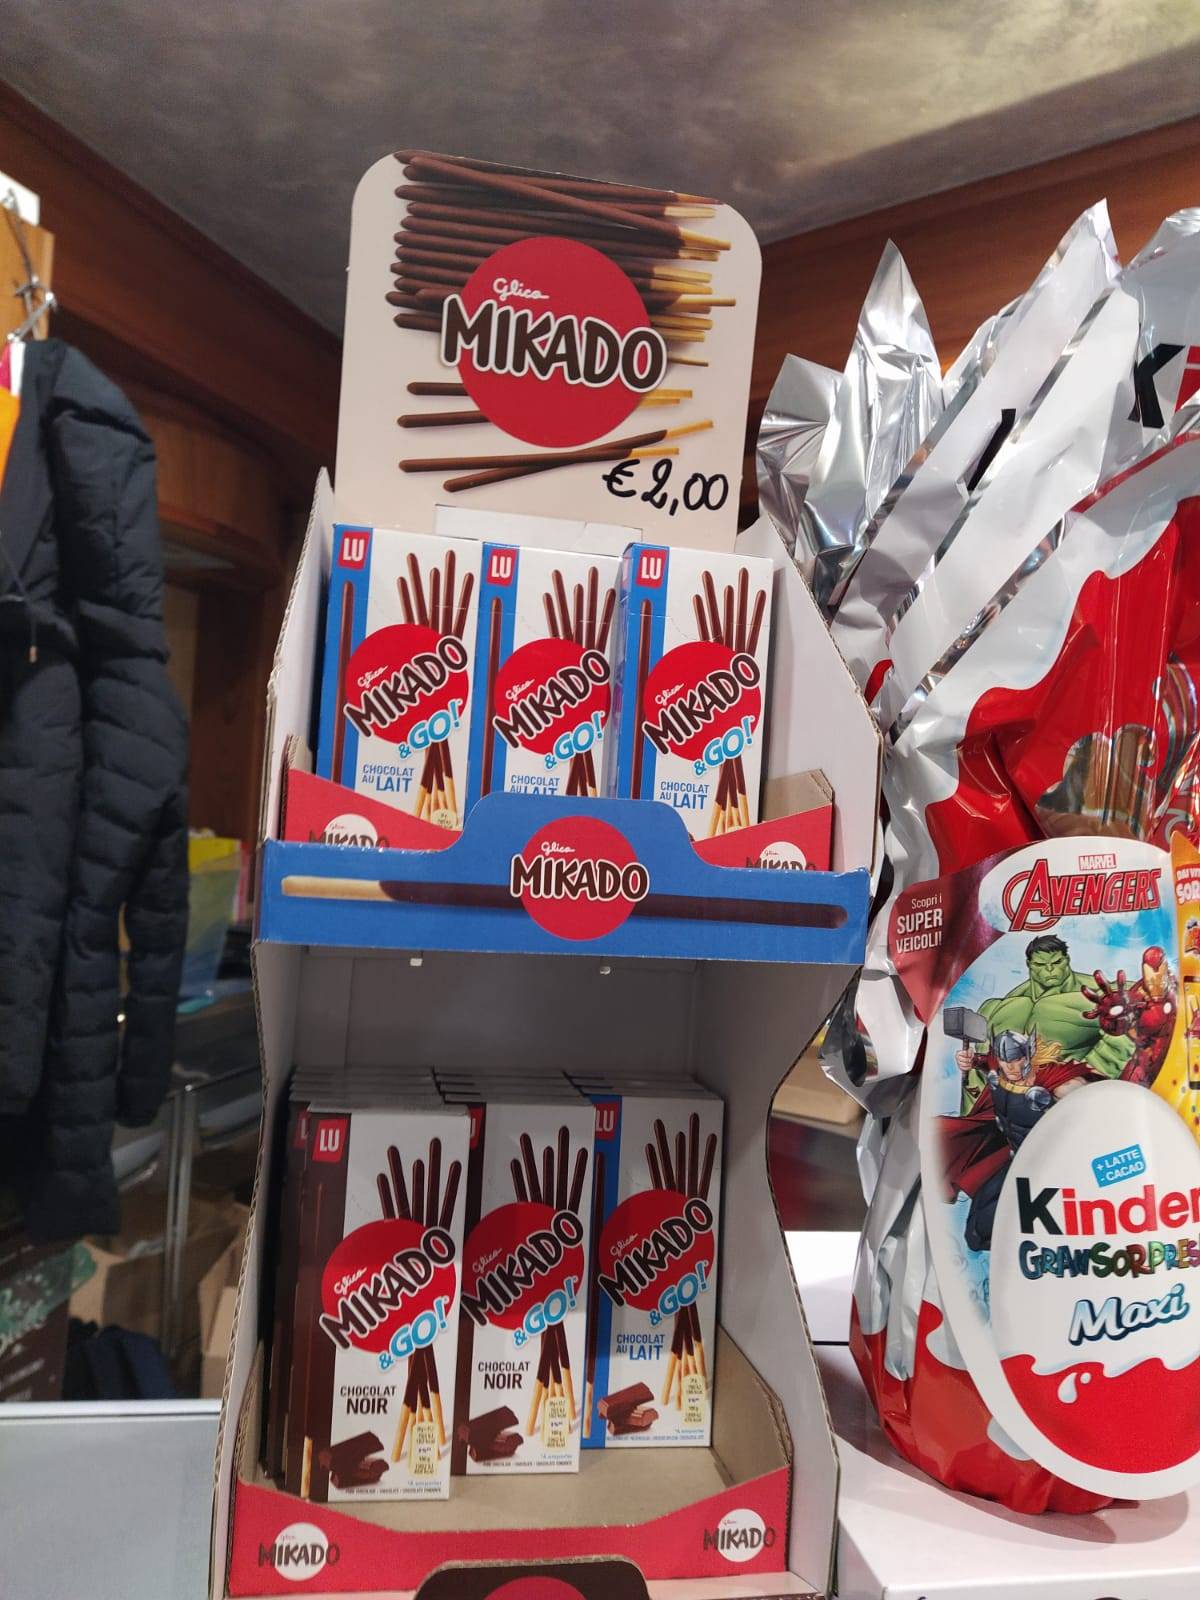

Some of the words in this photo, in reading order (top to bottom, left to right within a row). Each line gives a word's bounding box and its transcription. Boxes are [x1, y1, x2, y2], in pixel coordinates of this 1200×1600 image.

[441, 294, 668, 392] MIKADO
[343, 538, 365, 561] LU
[492, 556, 512, 578] LU
[641, 556, 662, 579] LU
[344, 636, 468, 737] MIKADO
[493, 650, 611, 748] MIKADO
[642, 652, 760, 754] MIKADO
[409, 701, 459, 749] GO!
[553, 713, 603, 759] GO!
[704, 719, 752, 765] GO!
[363, 765, 414, 776] CHOCOLAT
[511, 775, 560, 787] CHOCOLAT
[362, 775, 374, 784] AU
[376, 776, 412, 792] LAIT
[660, 781, 709, 793] CHOCOLAT
[660, 791, 671, 800] AU
[673, 792, 707, 809] LAIT
[1079, 854, 1116, 870] MARVEL
[510, 854, 649, 902] MIKADO
[911, 898, 938, 910] Scopri
[1002, 859, 1162, 931] AVENGERS
[897, 909, 943, 934] SUPER
[896, 931, 942, 954] VEICOLI!
[595, 1110, 614, 1132] LU
[320, 1129, 340, 1151] LU
[1105, 1149, 1140, 1168] LATTE
[1106, 1161, 1144, 1180] CACAO
[598, 1198, 713, 1307] MIKADO
[461, 1210, 584, 1326] MIKADO
[319, 1227, 456, 1349] MIKADO
[659, 1262, 709, 1316] GO!
[525, 1278, 577, 1335] GO!
[1069, 1283, 1190, 1346] Maxi
[390, 1298, 448, 1357] GO!
[616, 1334, 665, 1343] CHOCOLAT
[616, 1345, 627, 1353] AU
[629, 1345, 663, 1360] LAIT
[478, 1361, 530, 1372] CHOCOLAT
[340, 1386, 396, 1397] CHOCOLAT
[484, 1373, 523, 1389] NOIR
[346, 1398, 388, 1414] NOIR
[703, 1526, 776, 1551] MIKADO
[258, 1542, 340, 1567] MIKADO
